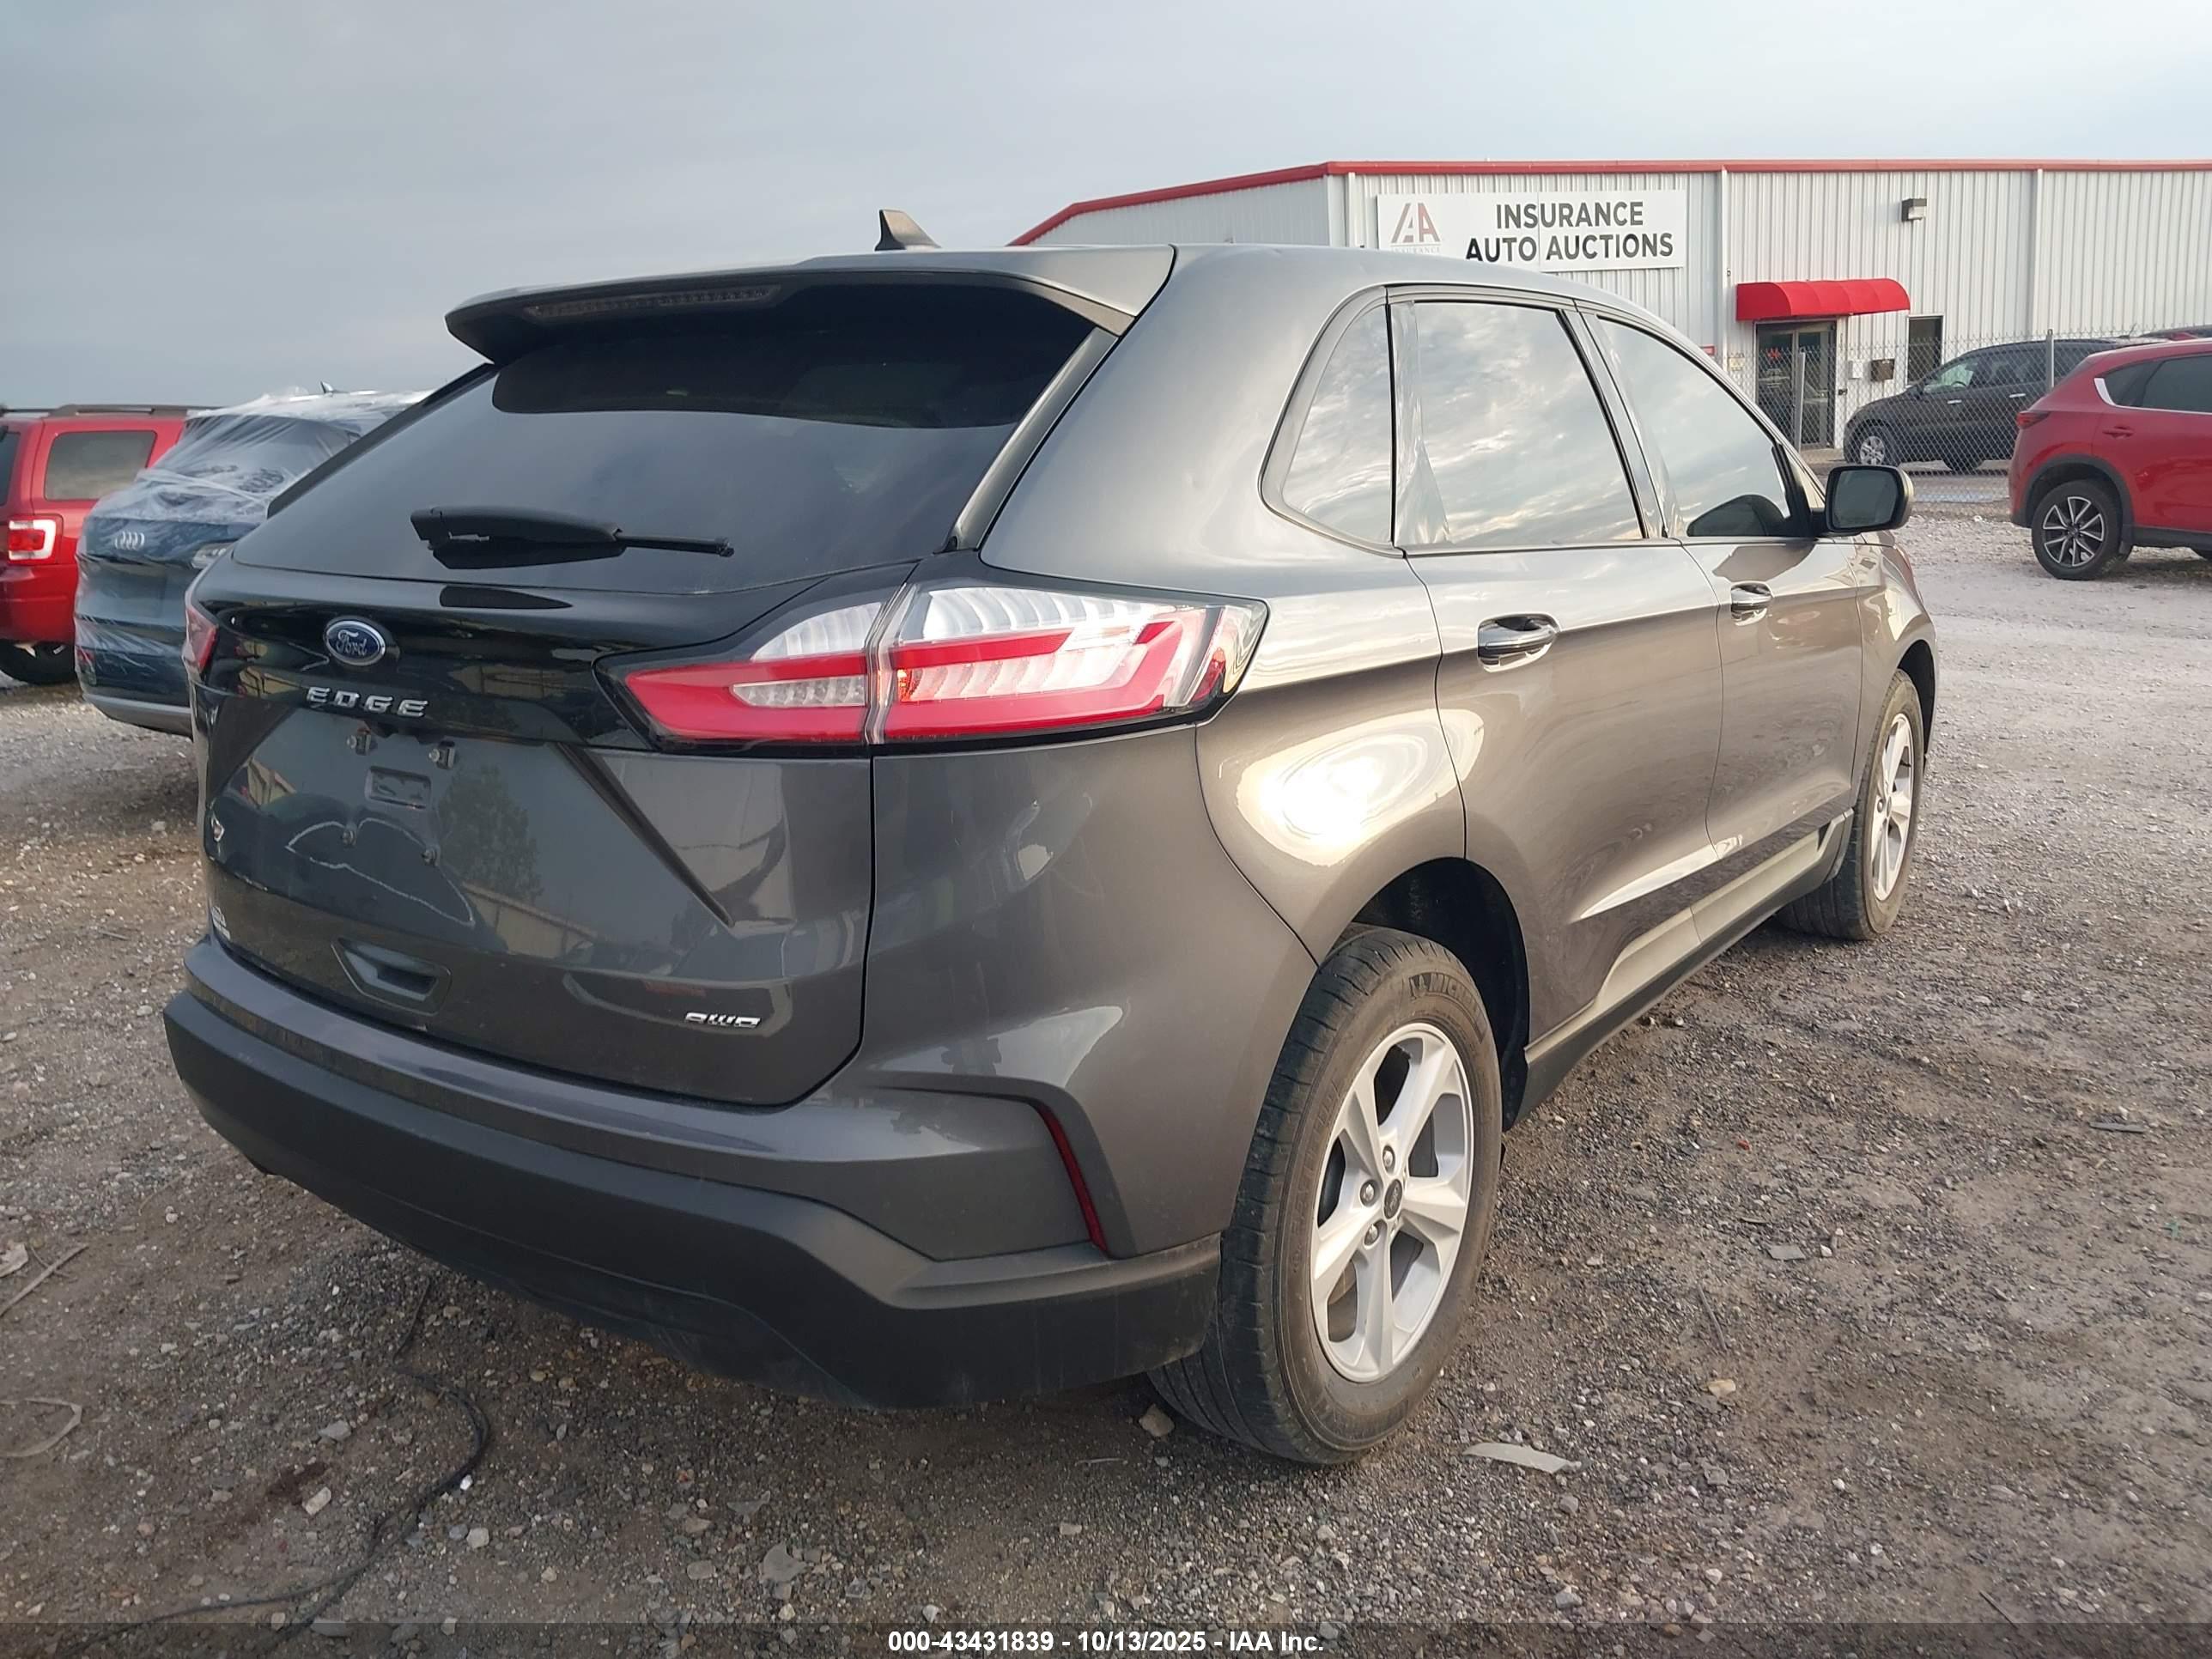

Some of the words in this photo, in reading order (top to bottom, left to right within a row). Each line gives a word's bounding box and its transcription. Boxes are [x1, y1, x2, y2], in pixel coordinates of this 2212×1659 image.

[1497, 202, 1644, 229] INSURANCE
[1465, 236, 1537, 263] AUTO
[1547, 233, 1673, 260] AUCTIONS
[336, 629, 368, 657] Ford
[307, 686, 428, 717] EDGE
[685, 1012, 761, 1028] AWD
